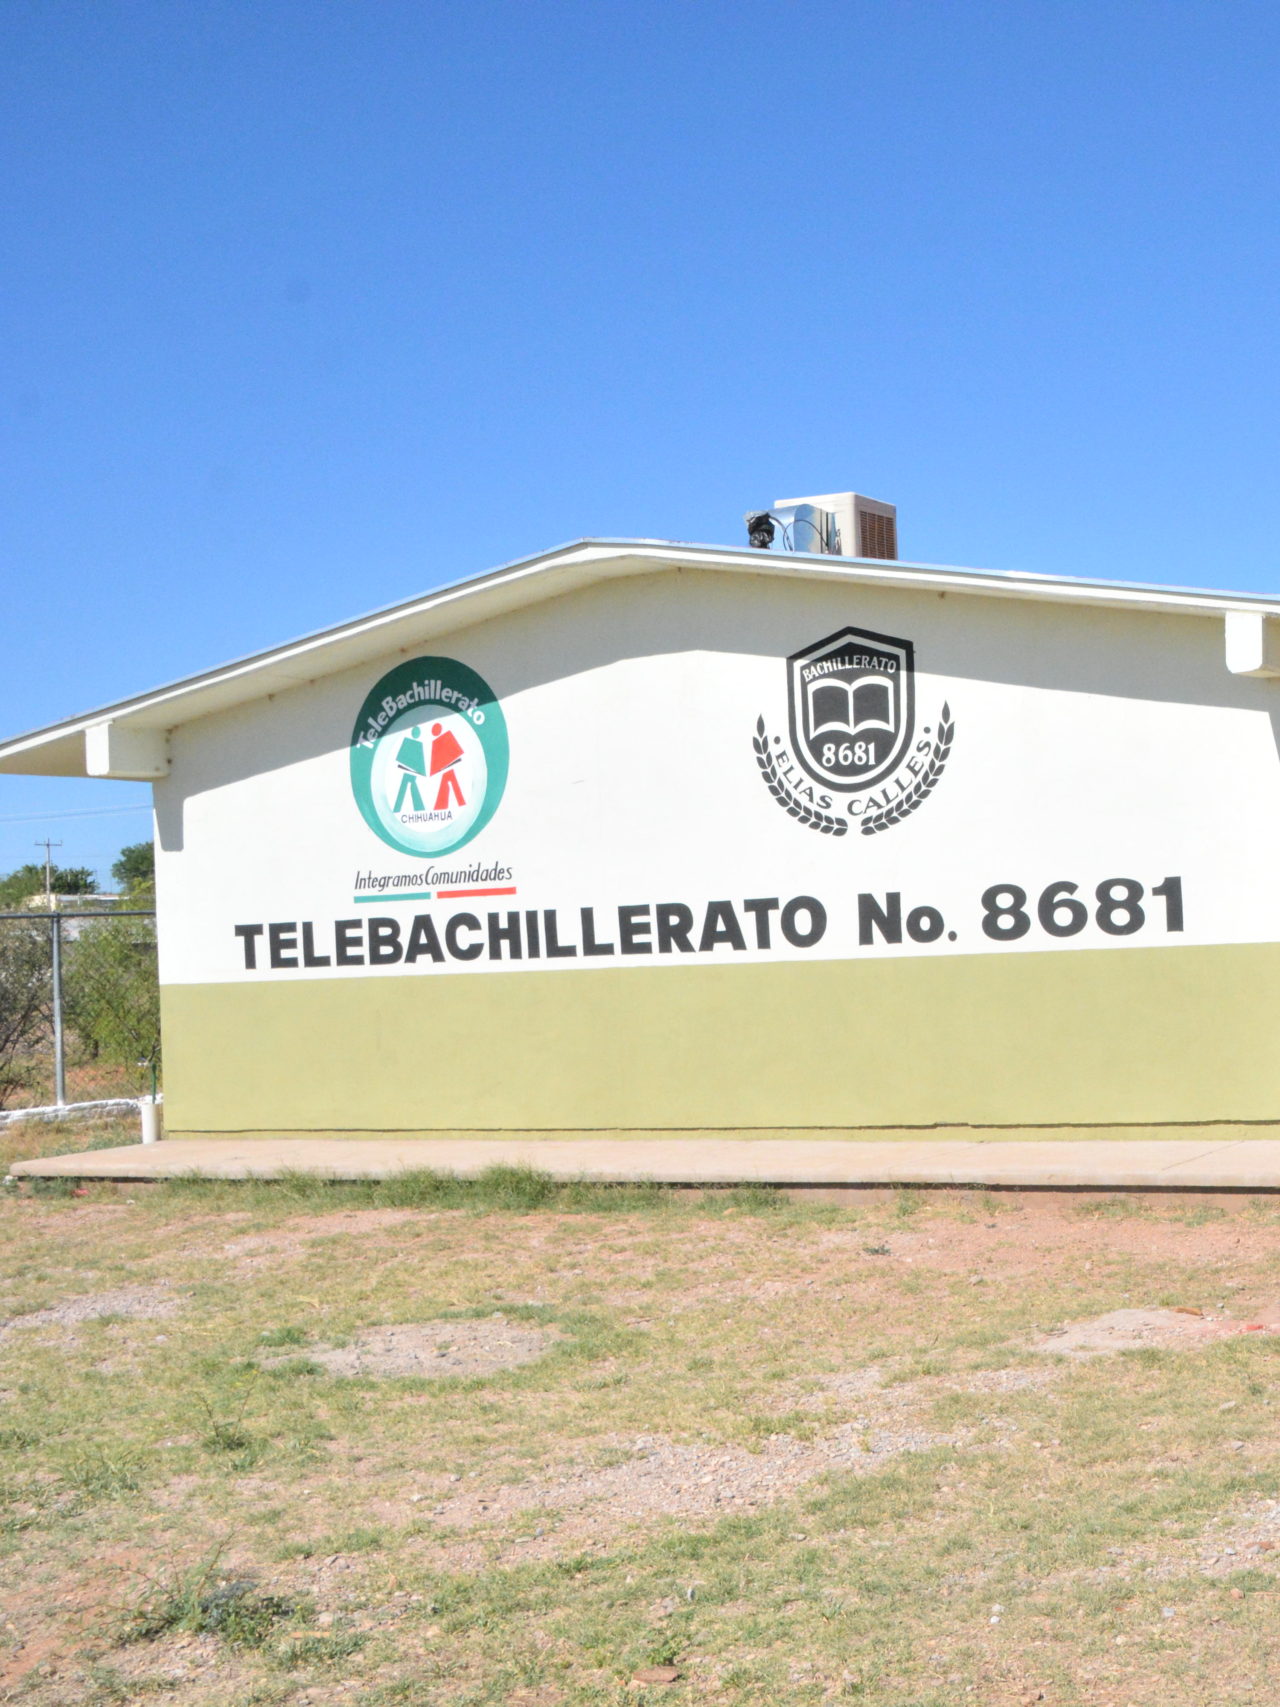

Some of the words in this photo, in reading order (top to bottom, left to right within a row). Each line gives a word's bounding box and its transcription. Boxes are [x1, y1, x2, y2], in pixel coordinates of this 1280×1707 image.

[802, 655, 897, 682] BACHILLERATO
[356, 679, 486, 750] TeleBachillerato
[774, 749, 833, 810] ELIAS
[846, 739, 932, 816] CALLES
[822, 741, 876, 767] 8681
[400, 810, 453, 824] CHIHUAHUA
[235, 896, 826, 969] TELEBACHILLERATO
[859, 893, 956, 944] No.
[982, 877, 1183, 940] 8681
